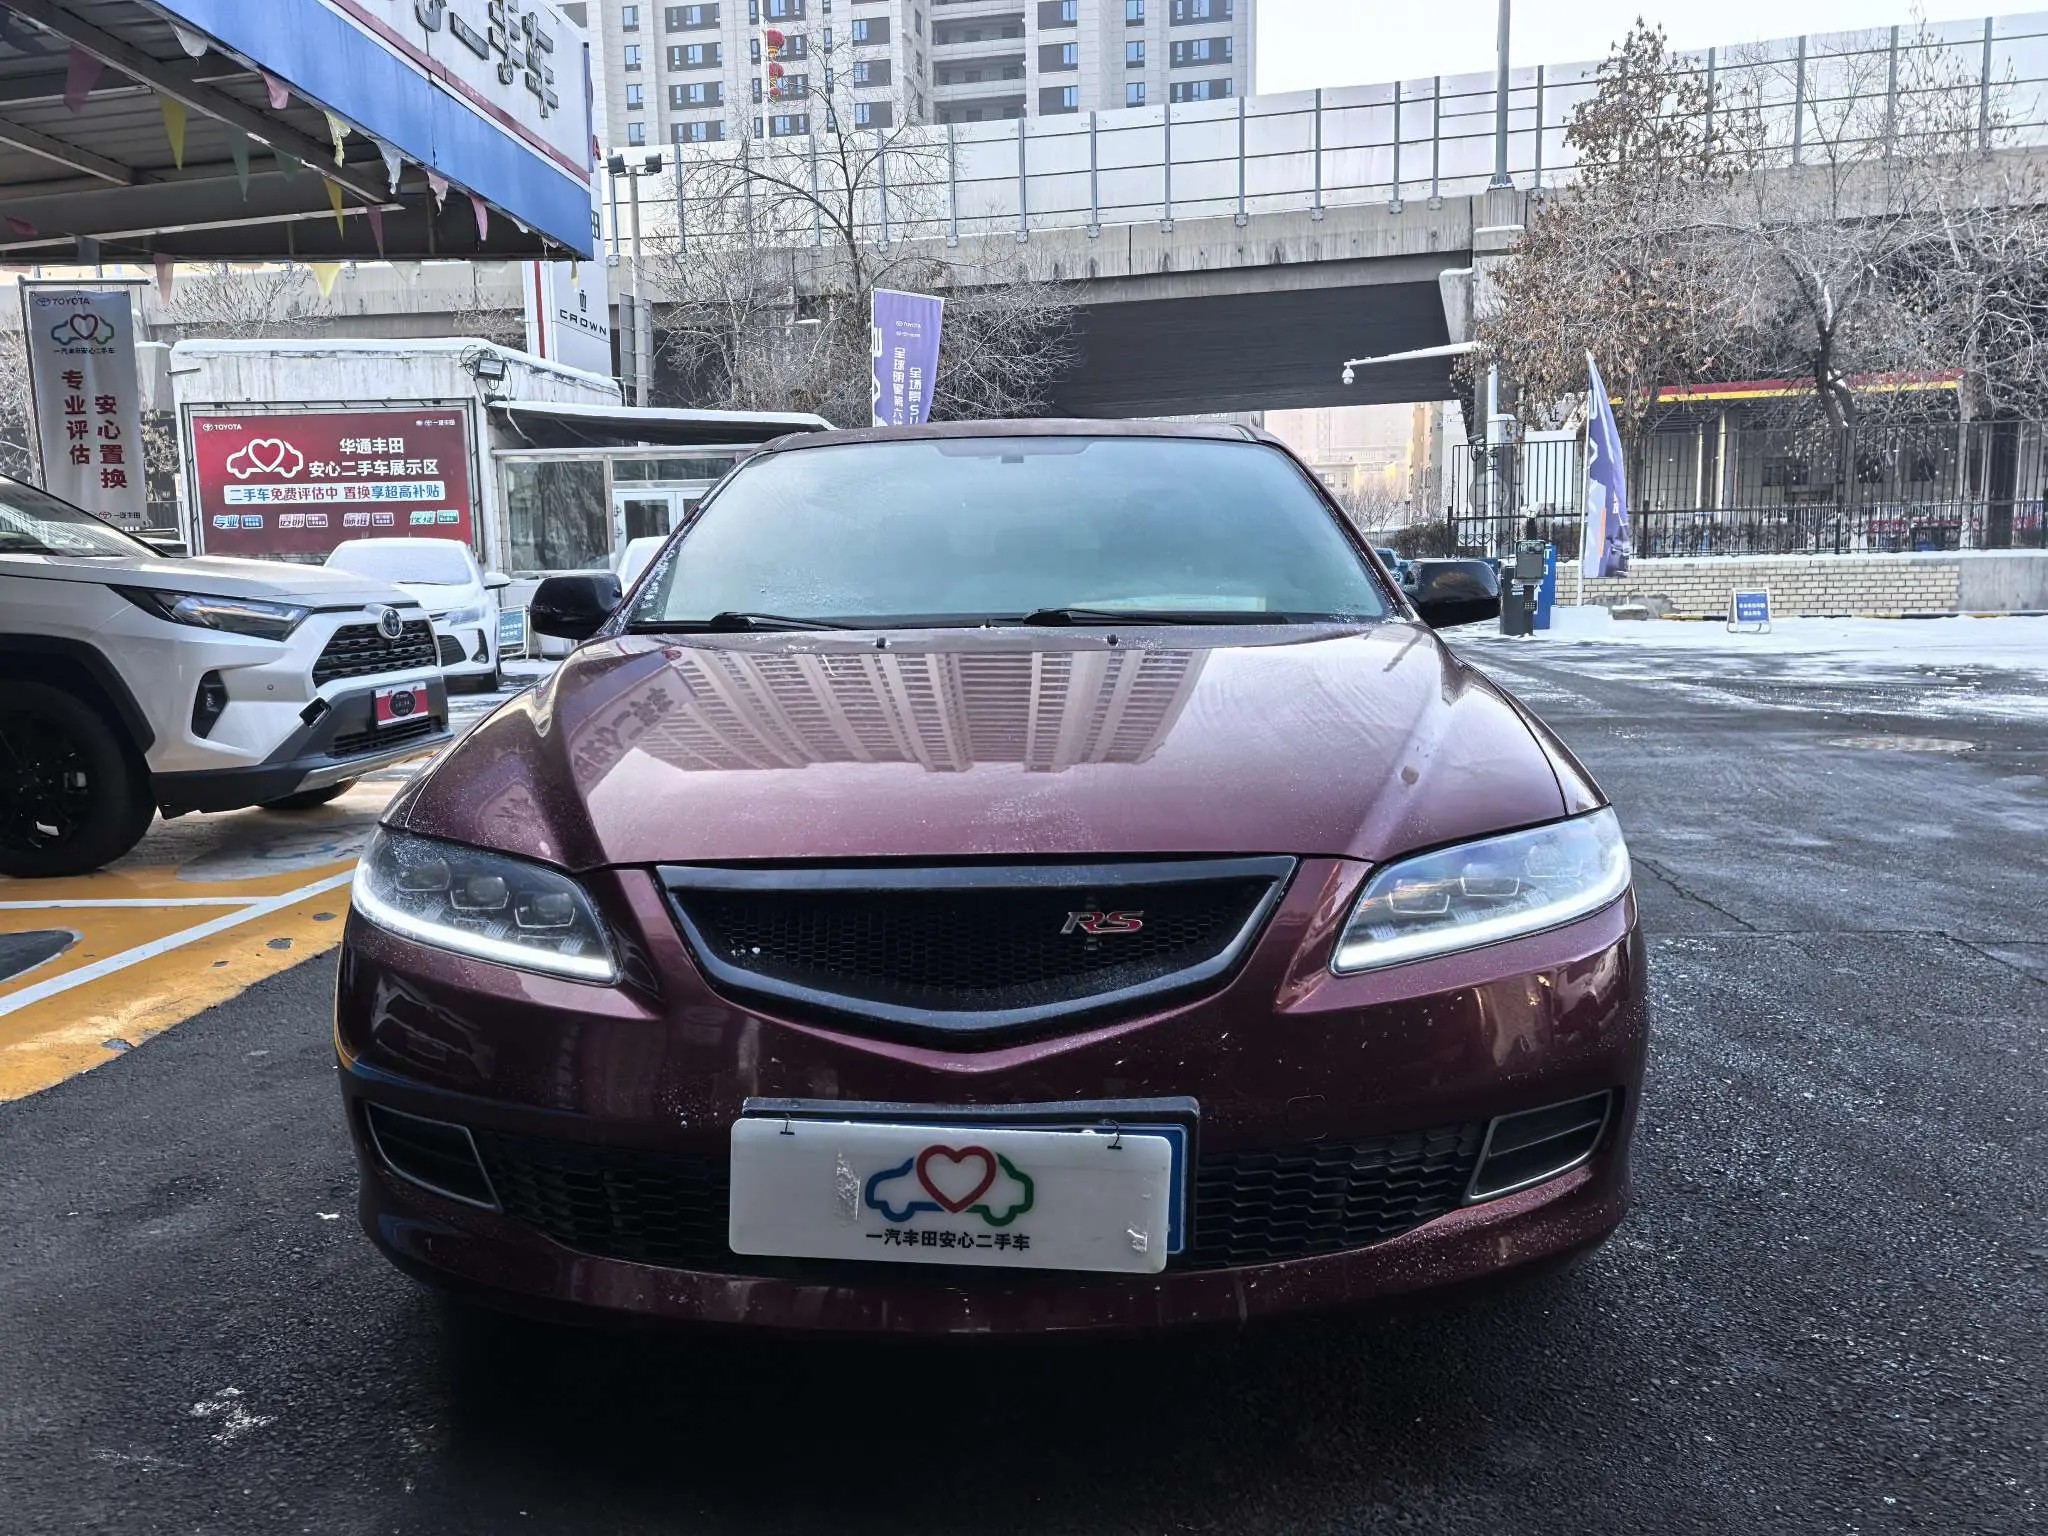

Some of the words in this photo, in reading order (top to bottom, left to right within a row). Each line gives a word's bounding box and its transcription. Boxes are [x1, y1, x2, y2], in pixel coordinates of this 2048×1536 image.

[52, 297, 91, 306] TOYOTA
[559, 309, 607, 336] CROWN
[62, 369, 90, 466] 专业评估
[95, 394, 128, 489] 安心置换
[339, 437, 404, 455] 华通丰田
[308, 458, 439, 478] 安心二手车展示区
[229, 487, 339, 502] 二手车免费评估中
[343, 483, 440, 500] 置换享超高补贴
[1060, 910, 1144, 935] RS
[865, 1228, 1031, 1251] 一汽丰田安心二手车
